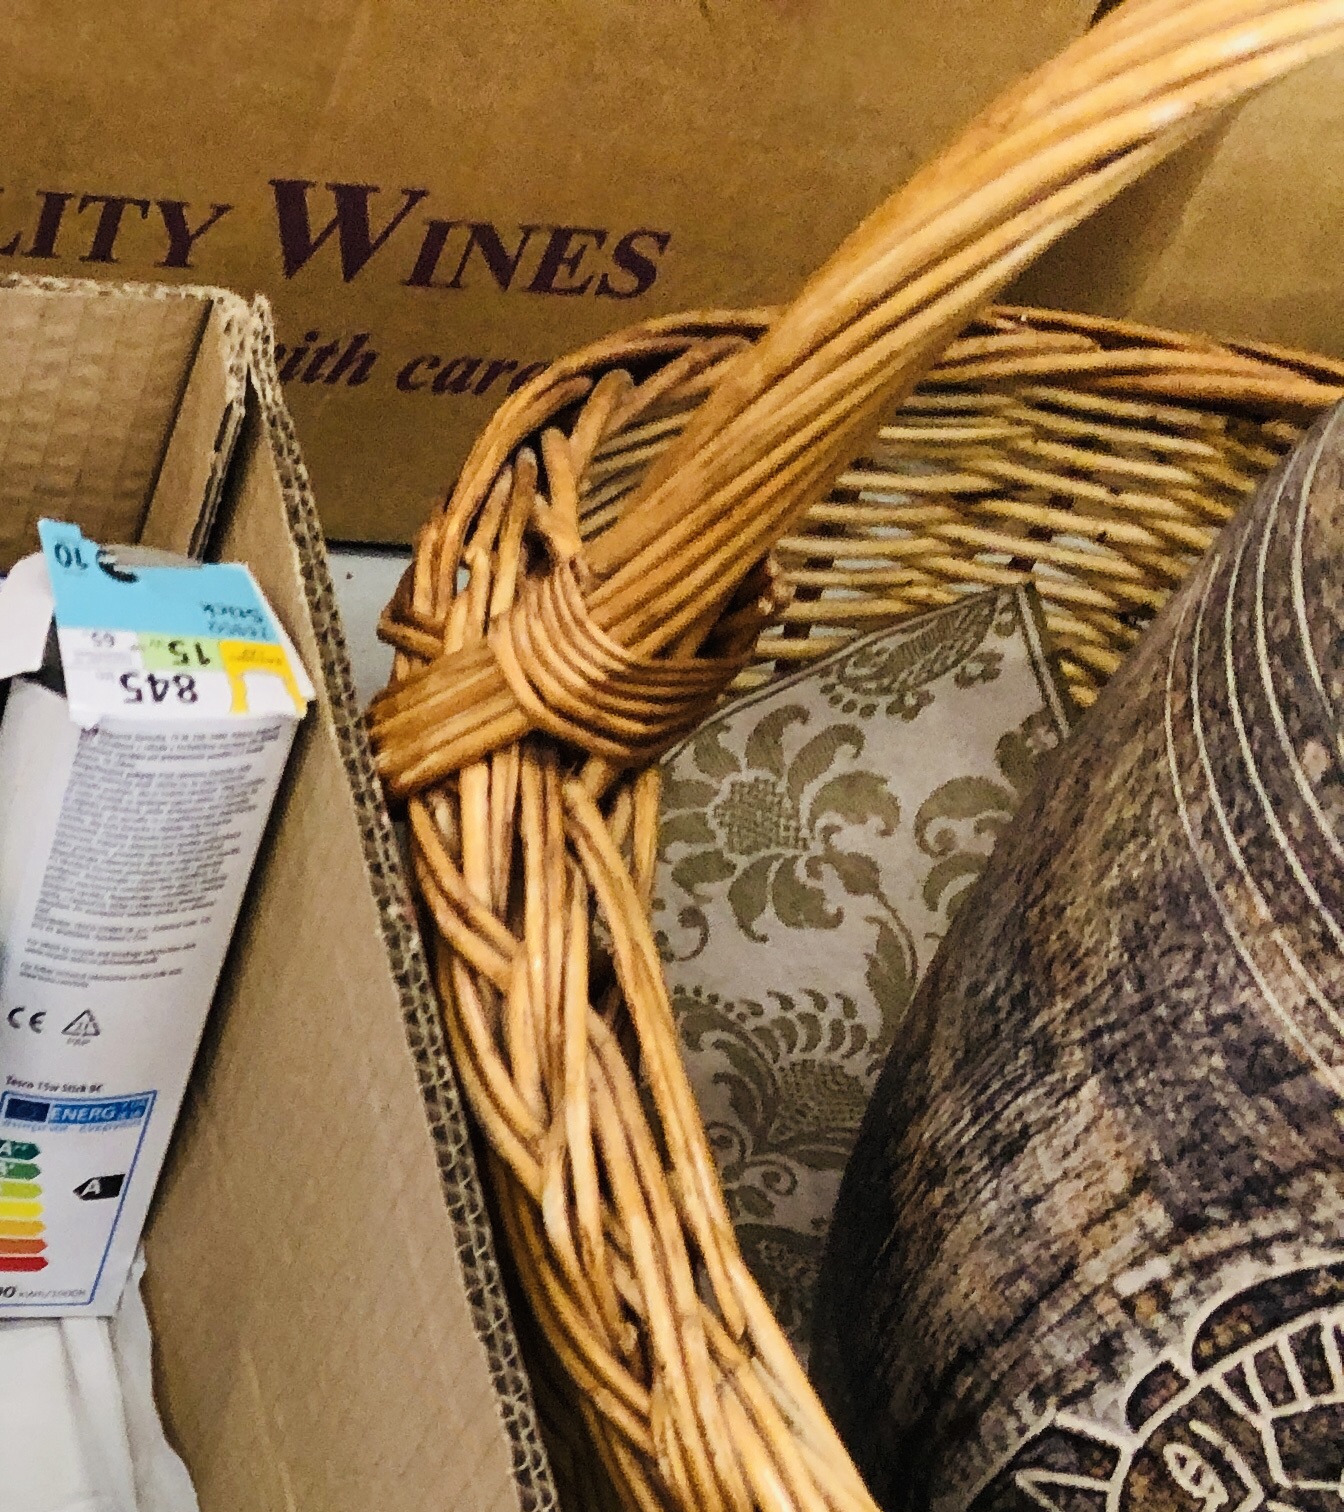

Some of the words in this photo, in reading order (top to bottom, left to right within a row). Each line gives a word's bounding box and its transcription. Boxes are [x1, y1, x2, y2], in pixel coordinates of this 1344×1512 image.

[268, 178, 670, 300] WINES
[275, 329, 378, 387] ith
[54, 544, 88, 570] 10
[120, 672, 198, 703] 845
